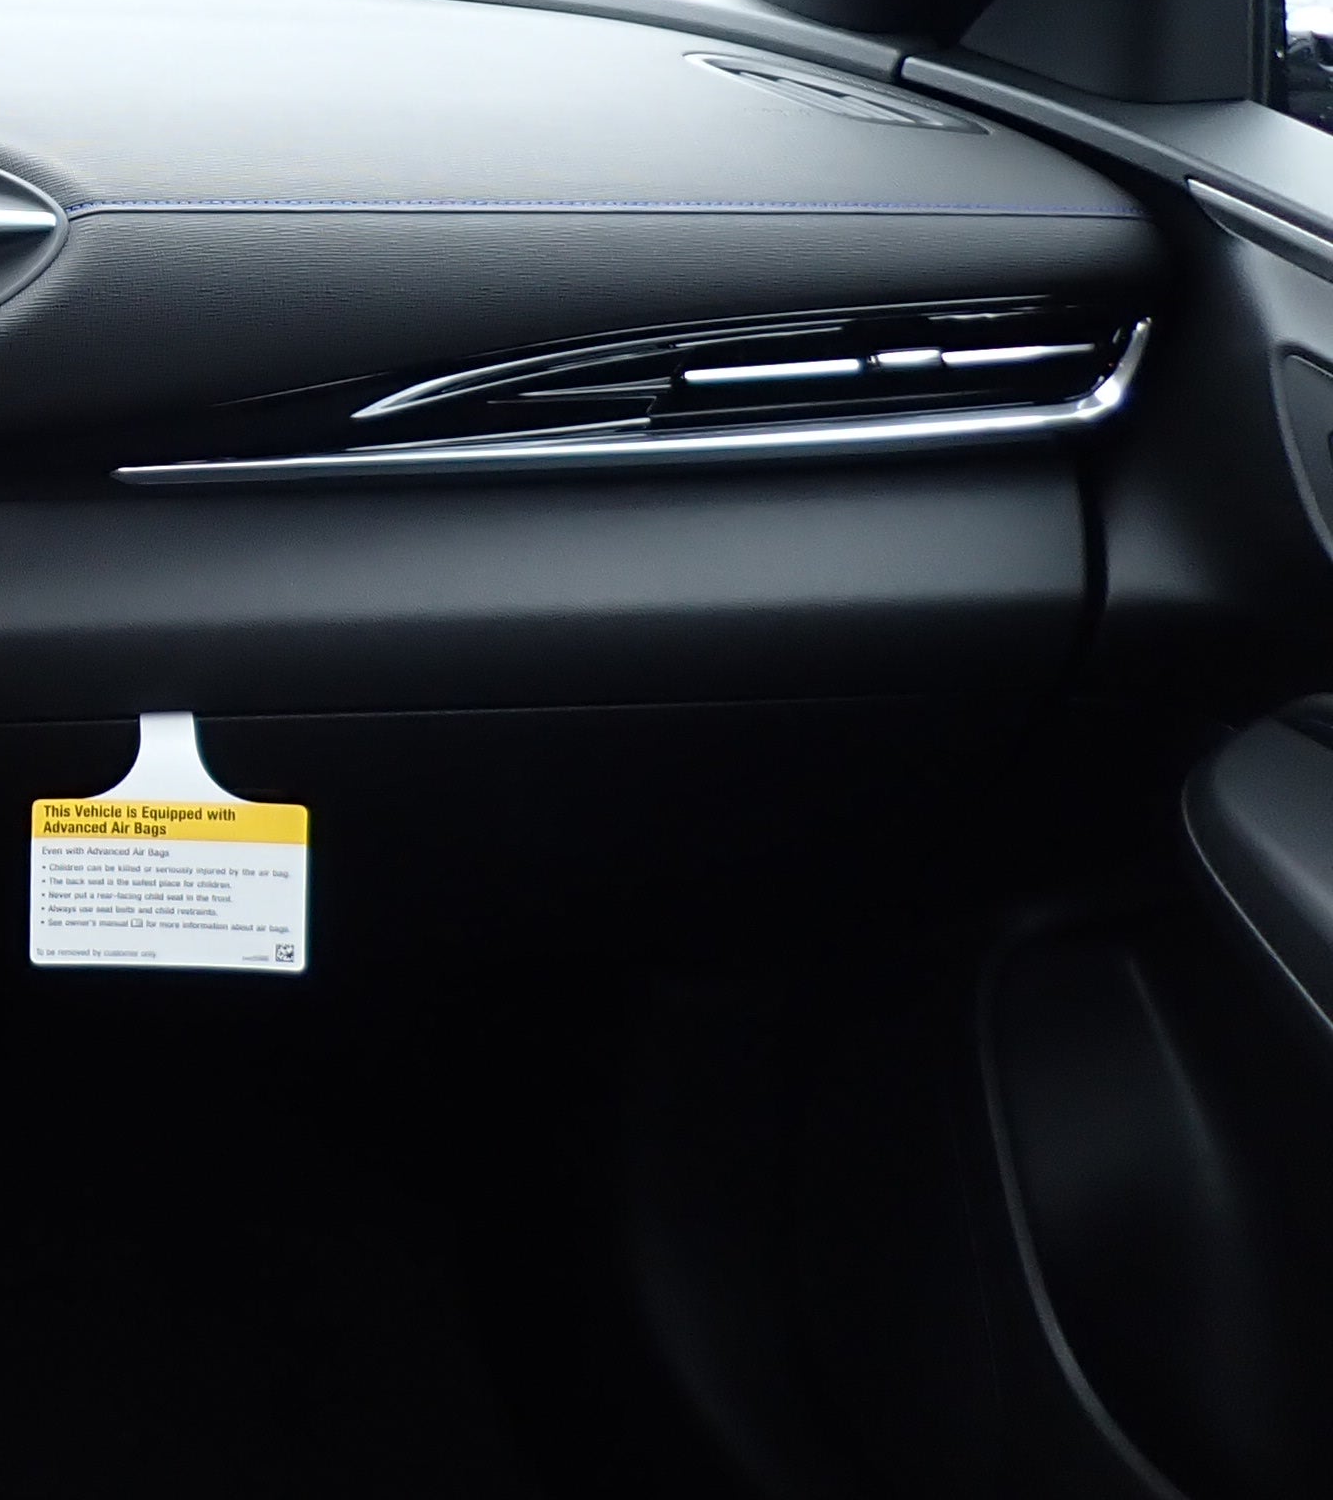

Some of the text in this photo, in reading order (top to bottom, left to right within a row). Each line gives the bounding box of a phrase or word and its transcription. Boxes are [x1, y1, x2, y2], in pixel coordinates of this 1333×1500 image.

[44, 805, 70, 819] This
[75, 805, 121, 819] Vehicle
[141, 806, 202, 821] Equipped
[207, 808, 235, 821] with
[43, 821, 167, 837] Advanced Air Bags
[41, 846, 169, 858] Even with Advanced Air Bags
[49, 864, 83, 872] Children
[105, 864, 115, 872] be
[117, 865, 140, 873] killed
[155, 865, 193, 875] seriously
[196, 867, 225, 876] injured
[229, 868, 238, 877] by
[242, 868, 255, 876] the
[49, 877, 63, 885] The
[116, 878, 129, 886] the
[132, 879, 157, 887] safest
[159, 879, 181, 888] place
[184, 880, 194, 888] for
[49, 891, 72, 899] Never
[97, 891, 142, 901] rear-facing
[144, 892, 164, 900] child
[196, 894, 209, 902] the
[48, 905, 76, 914] Always
[138, 906, 153, 914] and
[48, 919, 62, 927] See
[65, 919, 97, 927] owner's
[146, 920, 156, 928] for
[182, 922, 228, 930] information
[231, 923, 253, 931] about
[58, 949, 90, 957] removed
[93, 949, 101, 958] by
[103, 950, 138, 958] customer
